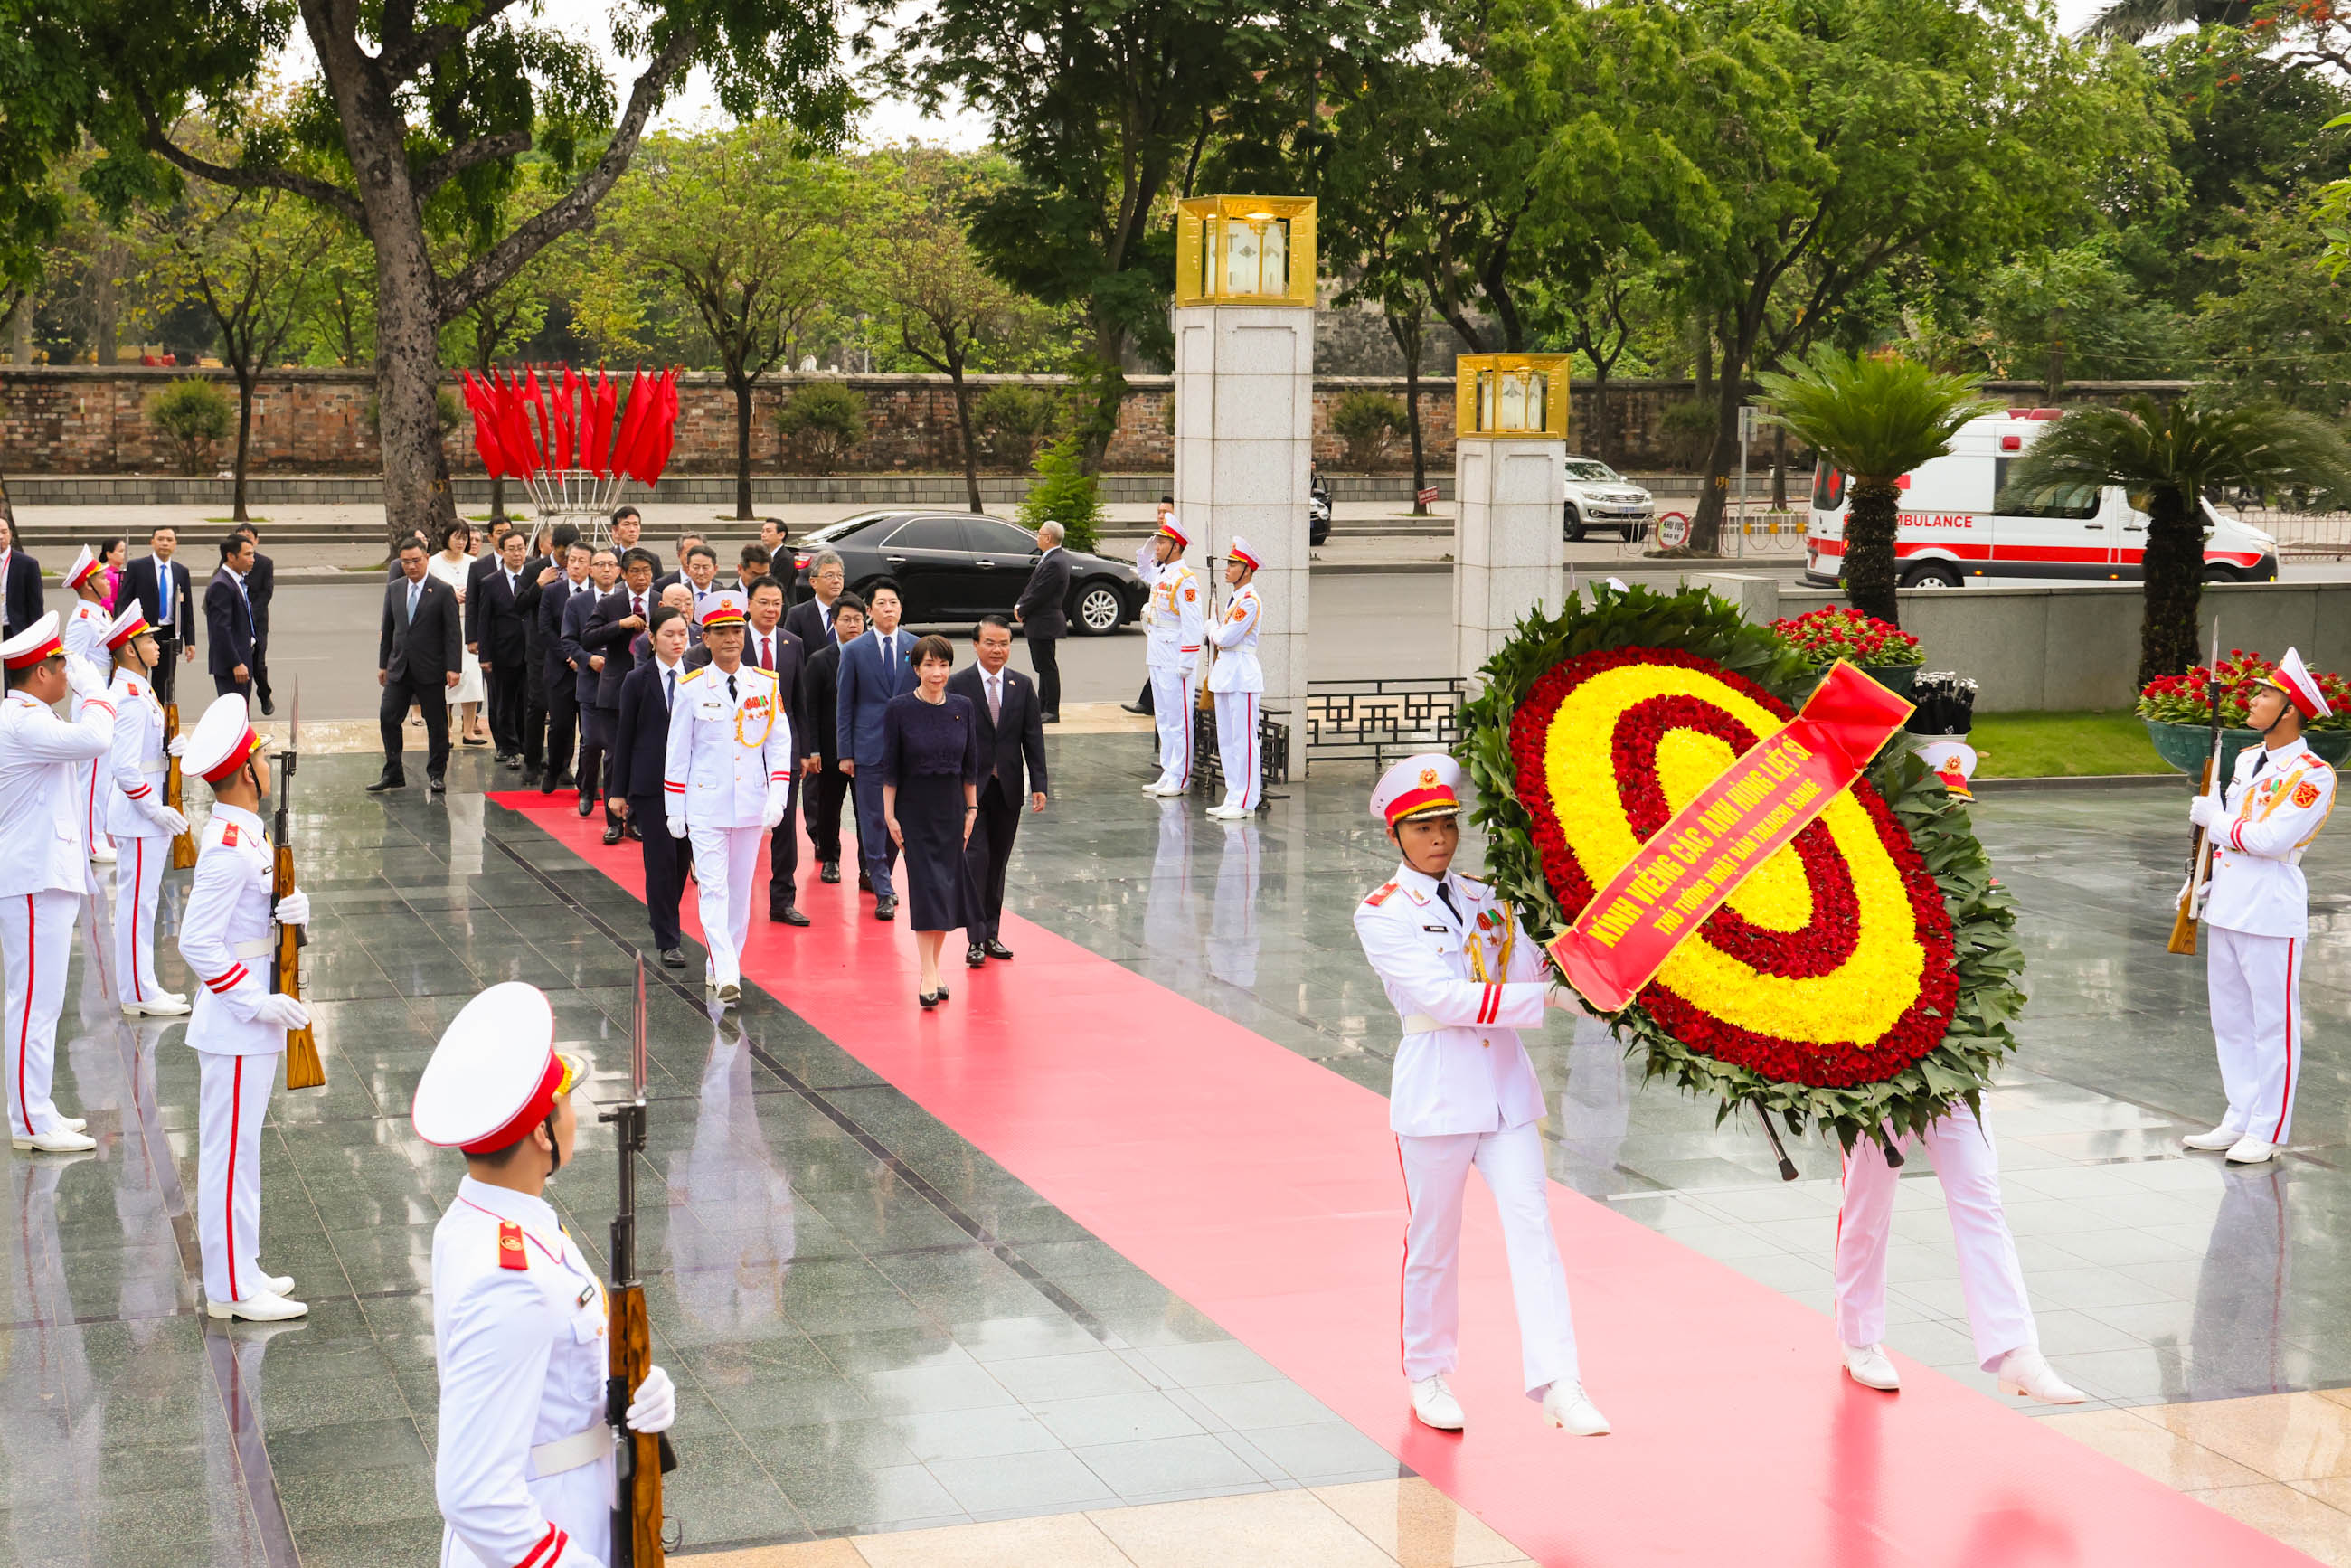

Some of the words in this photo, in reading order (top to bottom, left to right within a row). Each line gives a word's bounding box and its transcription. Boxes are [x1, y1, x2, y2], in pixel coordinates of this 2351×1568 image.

[1897, 515, 1972, 528] MBULANCE
[1587, 896, 1645, 948] KÍNH
[1625, 855, 1686, 905] VIẾNG
[1668, 827, 1714, 864] CÁC
[1697, 798, 1744, 838] ANH
[1725, 770, 1778, 813] HÙNG
[1758, 747, 1800, 782] LIỆT
[1653, 906, 1685, 936] THỦ
[1673, 878, 1716, 915] TƯỚNG
[1704, 853, 1740, 885] NHẬT
[1728, 837, 1760, 861] BẢN
[1748, 803, 1797, 844] TAKAICHI
[1785, 778, 1824, 810] SANAE
